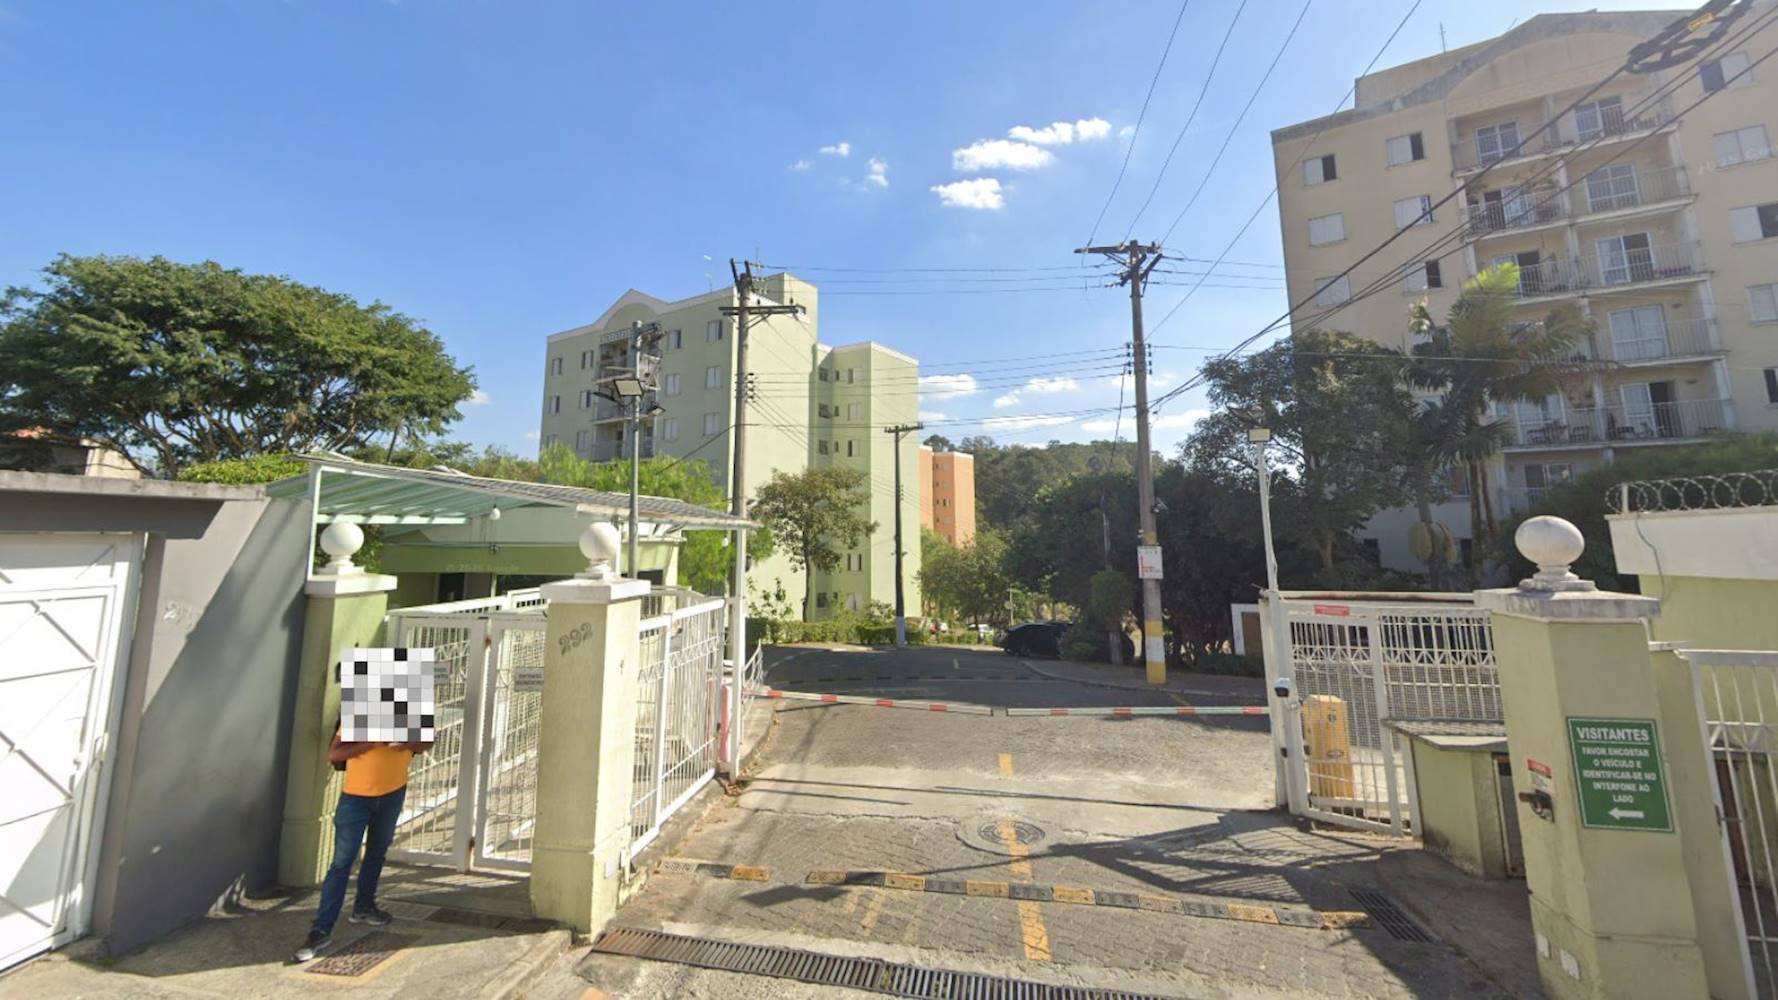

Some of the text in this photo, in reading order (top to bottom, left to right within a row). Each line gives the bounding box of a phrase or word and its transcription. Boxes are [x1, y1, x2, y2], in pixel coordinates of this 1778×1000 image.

[559, 622, 592, 656] 292
[1576, 727, 1649, 741] VISITANTES
[1582, 747, 1649, 757] FAVOR ENCOSTAR
[1593, 759, 1599, 767] O
[1636, 760, 1642, 768] E
[1582, 770, 1657, 781] IDENTIFICAR-SE NO
[1593, 781, 1650, 792] INTERFONE AO
[1613, 794, 1634, 803] LADO
